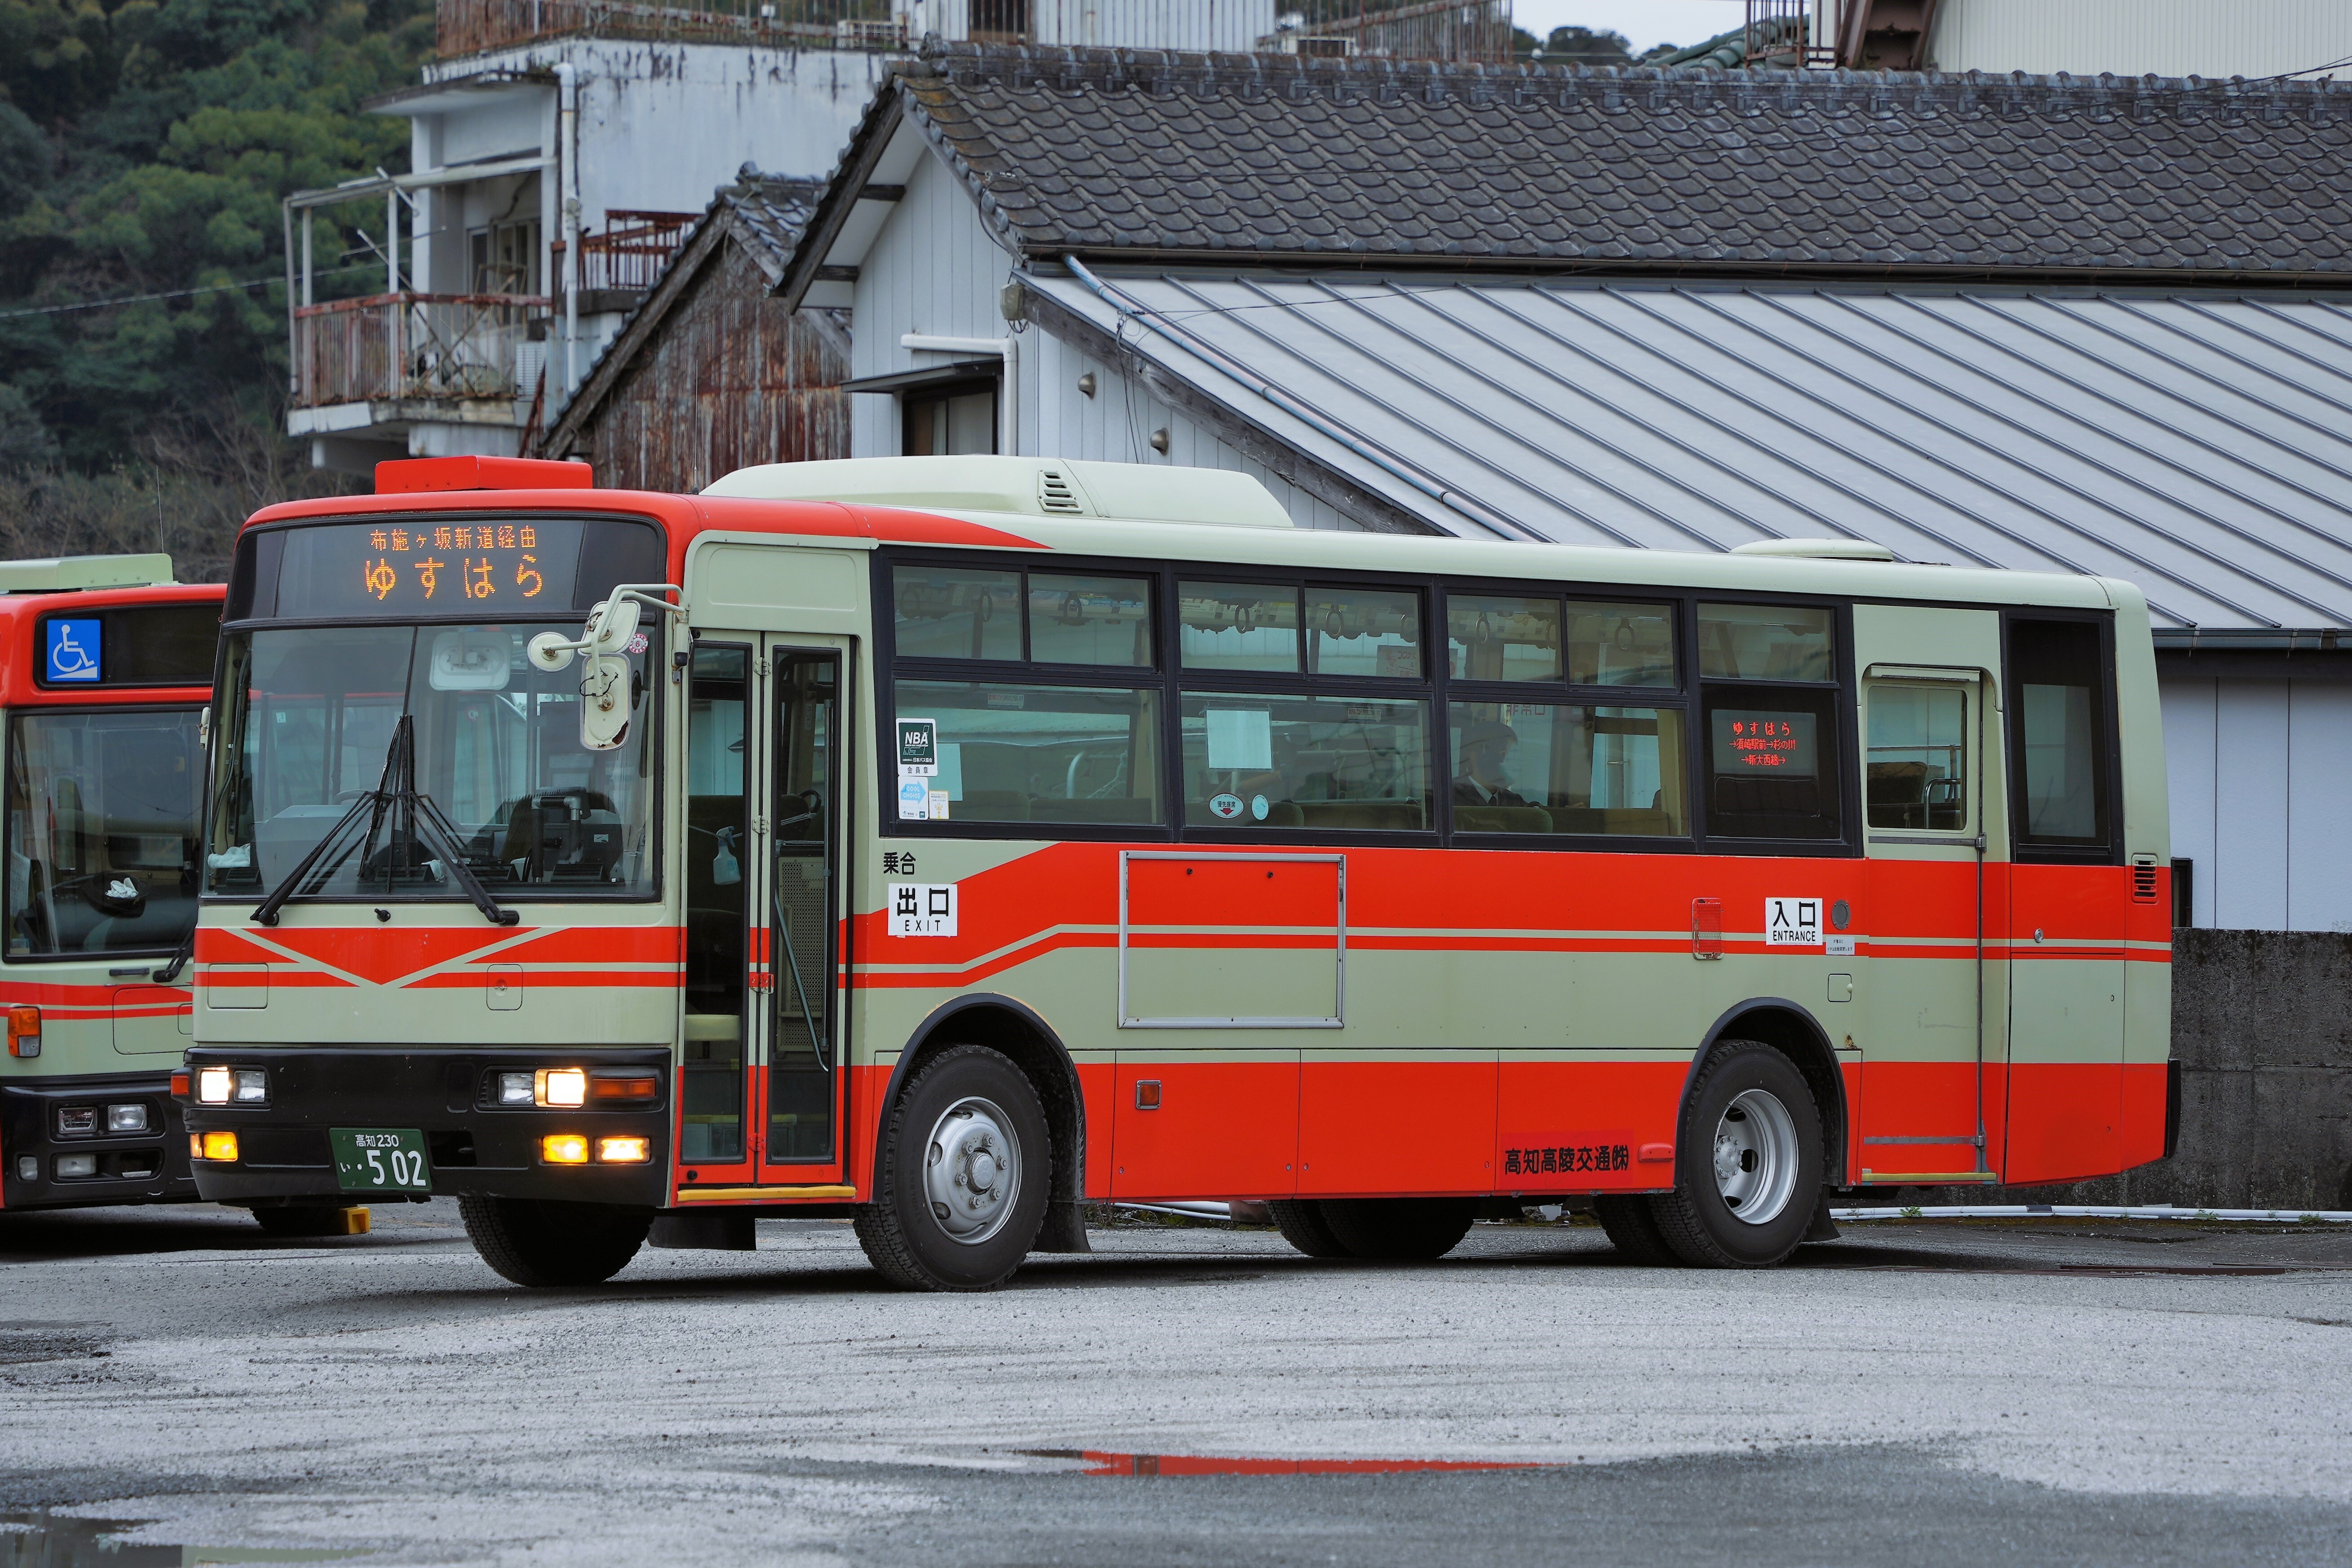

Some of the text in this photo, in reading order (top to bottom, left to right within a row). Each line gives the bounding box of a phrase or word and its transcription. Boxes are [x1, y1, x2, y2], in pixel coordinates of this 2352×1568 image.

[364, 554, 543, 601] ゆすはら
[1732, 721, 1791, 736] ゆすはら
[904, 732, 929, 745] NBA
[883, 851, 916, 875] 乗合
[897, 888, 949, 917] 出口
[1773, 901, 1816, 928] 入口
[905, 919, 941, 932] EXIT
[1773, 930, 1816, 942] ENTRANCE
